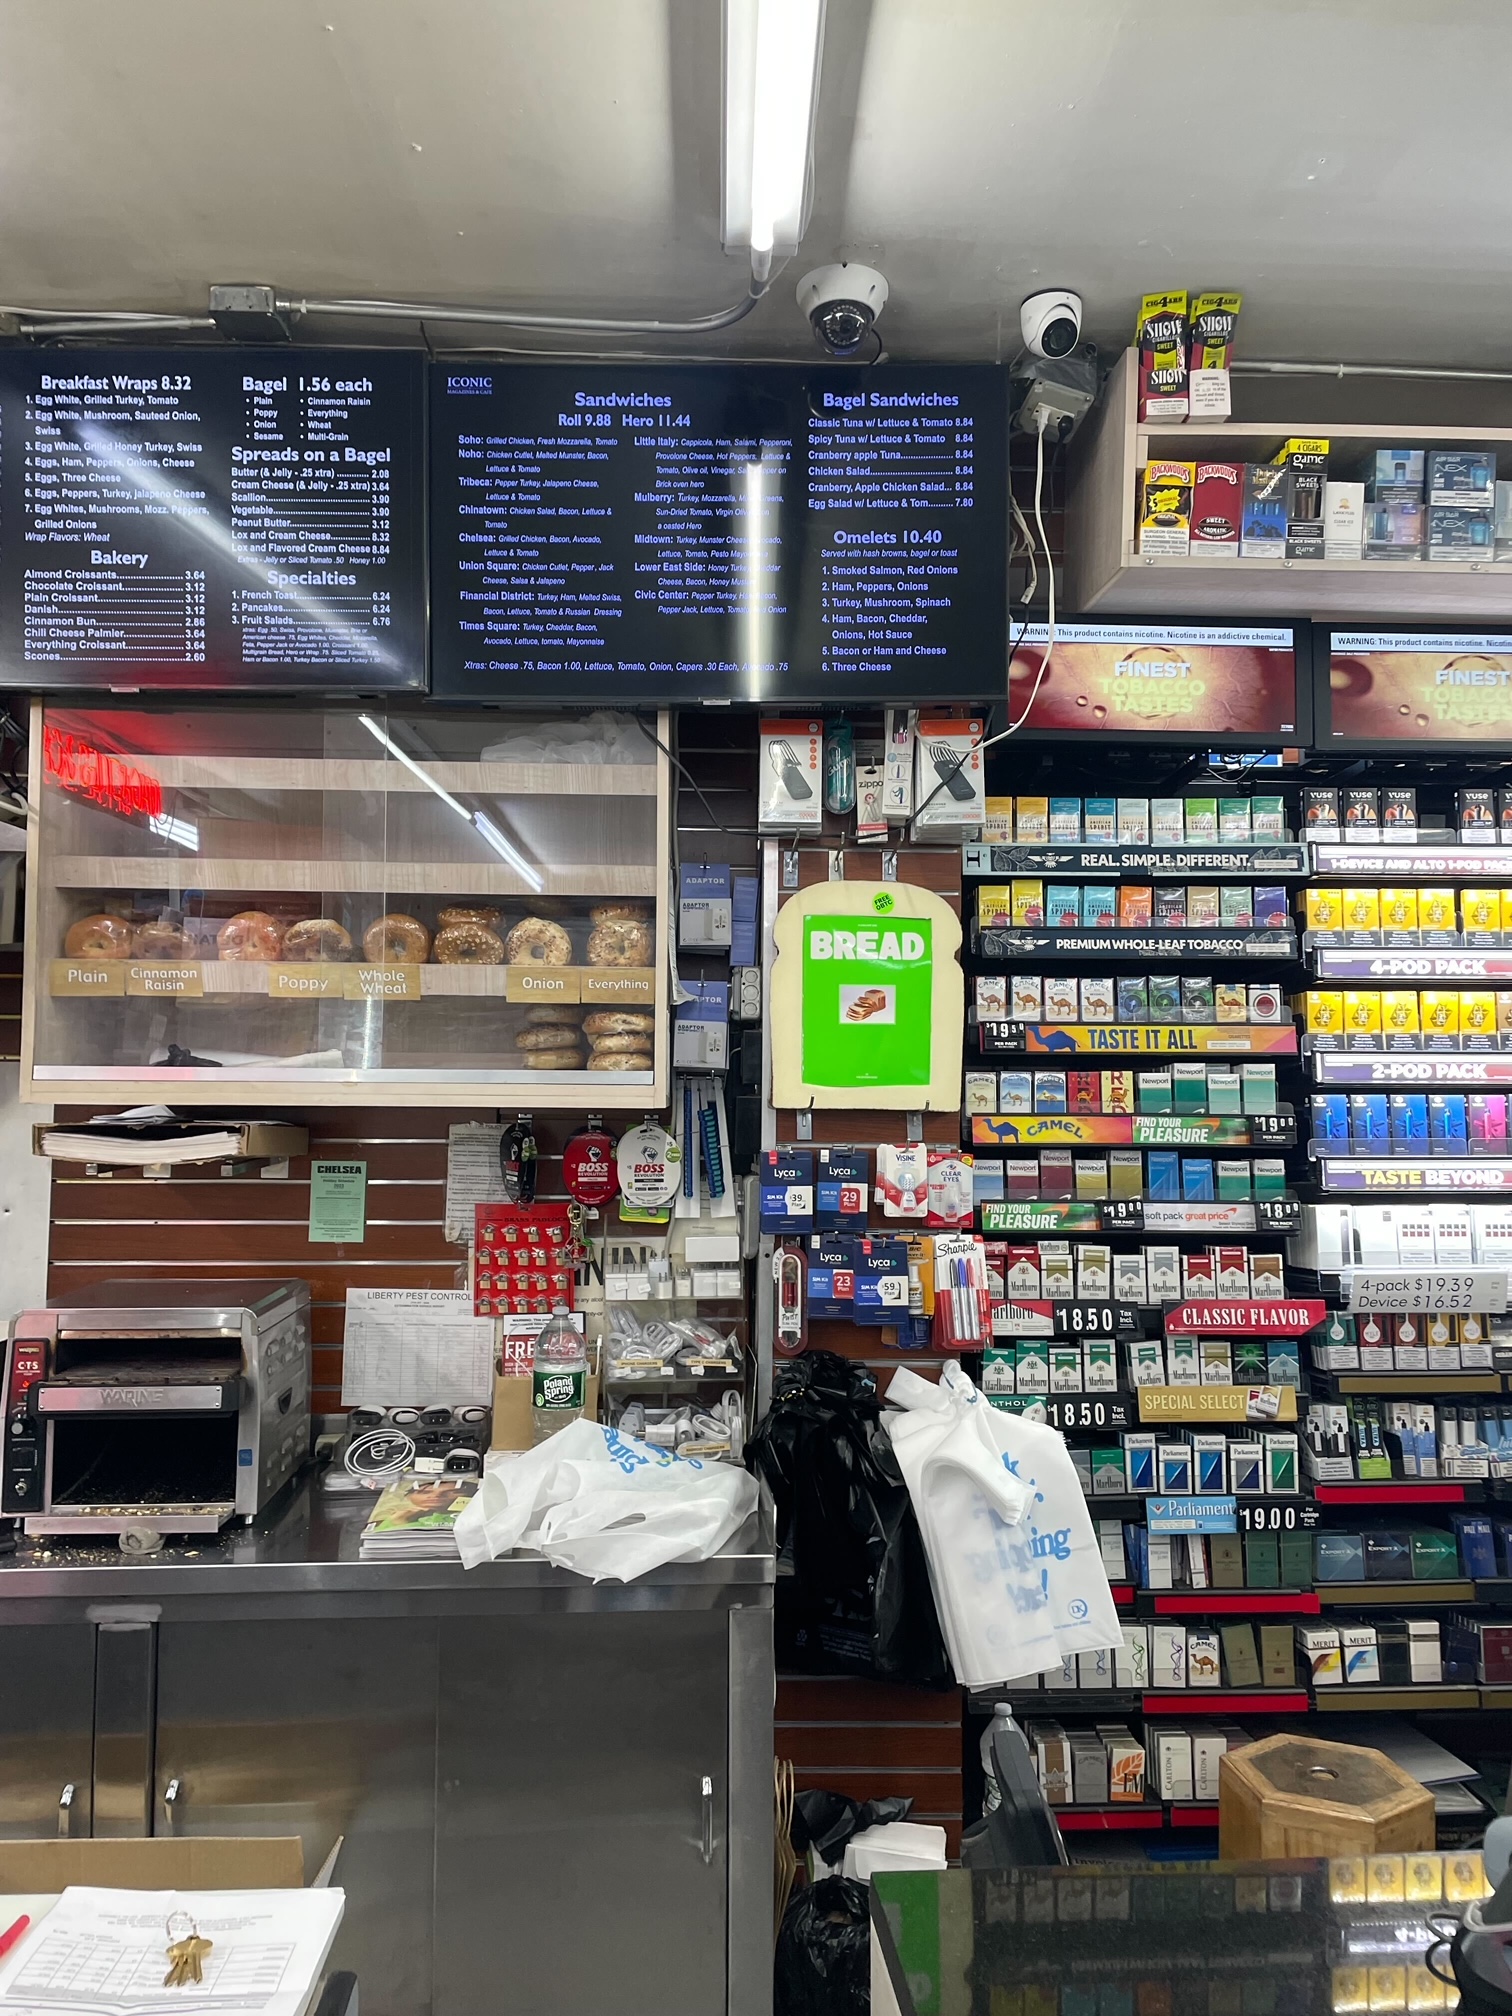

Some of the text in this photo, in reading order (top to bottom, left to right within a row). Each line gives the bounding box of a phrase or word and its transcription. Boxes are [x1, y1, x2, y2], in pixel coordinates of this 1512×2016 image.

[41, 375, 192, 394] Breakfast Wraps 8.32
[243, 377, 372, 395] Bagel 1.56 each
[447, 377, 492, 387] ICONIC
[26, 395, 179, 406] 1. Egg White, Grilled Turkey, Tomato
[308, 397, 345, 405] Cinnamon
[575, 392, 672, 407] Sandwiches
[823, 393, 958, 410] Bagel Sandwiches
[254, 409, 278, 418] Poppy
[308, 409, 348, 419] Everything
[308, 421, 331, 429] Wheat
[558, 414, 691, 427] Roll 9.88 Hero 11.44
[808, 418, 973, 427] Classic Tuna w/ Lettuce & Tomato 8.84
[308, 433, 349, 441] Multi-Grain
[458, 435, 484, 445] Soho:
[486, 437, 507, 445] Grilled
[509, 437, 536, 446] Chicken,
[557, 438, 593, 446] Mozzarella,
[635, 437, 678, 447] Little Italy:
[1303, 444, 1322, 452] CIGARS
[232, 446, 390, 465] Spreads on a Bagel
[1293, 455, 1324, 469] game
[1151, 464, 1189, 482] BACKWOODS
[1198, 464, 1237, 484] BACKWOODS
[834, 530, 942, 544] Omelets 10.40
[91, 550, 148, 568] Bakery
[268, 570, 356, 588] Specialties
[822, 598, 950, 608] 3. Turkey, Mushroom, Spinach
[1074, 630, 1098, 638] product
[1115, 662, 1190, 677] FINEST
[1100, 679, 1205, 695] TOBACCO
[1112, 696, 1193, 713] TASTES
[1310, 791, 1333, 799] vuse
[1081, 854, 1119, 866] REAL.
[1122, 854, 1175, 867] SIMPLE.
[1180, 854, 1250, 866] DIFFERENT.
[874, 895, 890, 904] FREE
[810, 931, 925, 960] BREAD
[1057, 939, 1113, 949] PREMIUM
[1114, 940, 1186, 950] WHOLE-LEAF
[1187, 940, 1243, 950] TOBACCO
[1370, 960, 1486, 974] 4-POD PACK
[68, 970, 107, 984] Plain
[131, 968, 197, 979] Cinnamon
[359, 970, 405, 983] Whole
[145, 979, 184, 990] Raisin
[278, 976, 329, 991] Poppy
[360, 982, 407, 994] Wheat
[522, 977, 564, 990] Onion
[587, 979, 648, 991] Everything
[1088, 1029, 1197, 1049] TASTE IT ALL
[1177, 1068, 1204, 1076] Newport
[1372, 1064, 1487, 1079] 2-POD PACK
[1142, 1078, 1169, 1087] Newport
[1137, 1117, 1181, 1127] FIND YOUR
[1026, 1118, 1084, 1140] CAMEL
[1141, 1129, 1208, 1142] PLEASURE
[896, 1154, 916, 1162] VISINE
[318, 1166, 361, 1174] CHELSEA
[578, 1163, 608, 1171] BOSS
[634, 1164, 664, 1173] BOSS
[829, 1167, 850, 1176] Lyca
[774, 1169, 795, 1178] Lyca
[1362, 1170, 1504, 1185] TASTE BEYOND
[986, 1205, 1031, 1214] FIND YOUR
[990, 1215, 1057, 1229] PLEASURE
[1163, 1213, 1183, 1221] pack
[1185, 1213, 1205, 1221] great
[1207, 1212, 1228, 1220] price
[937, 1242, 977, 1257] Sharpie
[820, 1253, 841, 1262] Lyca
[868, 1258, 890, 1268] Lyca
[1011, 1278, 1038, 1292] Marlboro
[1220, 1282, 1248, 1292] Marlboro
[1361, 1278, 1474, 1293] 4-pack $19.39
[367, 1292, 404, 1301] LIBERTY
[406, 1292, 428, 1300] PEST
[1359, 1295, 1472, 1308] Device $16.52
[1182, 1308, 1310, 1325] CLASSIC FLAVOR
[544, 1376, 573, 1390] Poland
[545, 1385, 574, 1400] Spring
[1145, 1395, 1244, 1410] SPECIAL SELECT
[1169, 1500, 1233, 1517] Parliament
[1190, 1640, 1216, 1651] CAMEL
[1313, 1640, 1335, 1648] MERIT
[1350, 1637, 1372, 1645] MERIT
[1165, 1757, 1173, 1790] CARLTON
